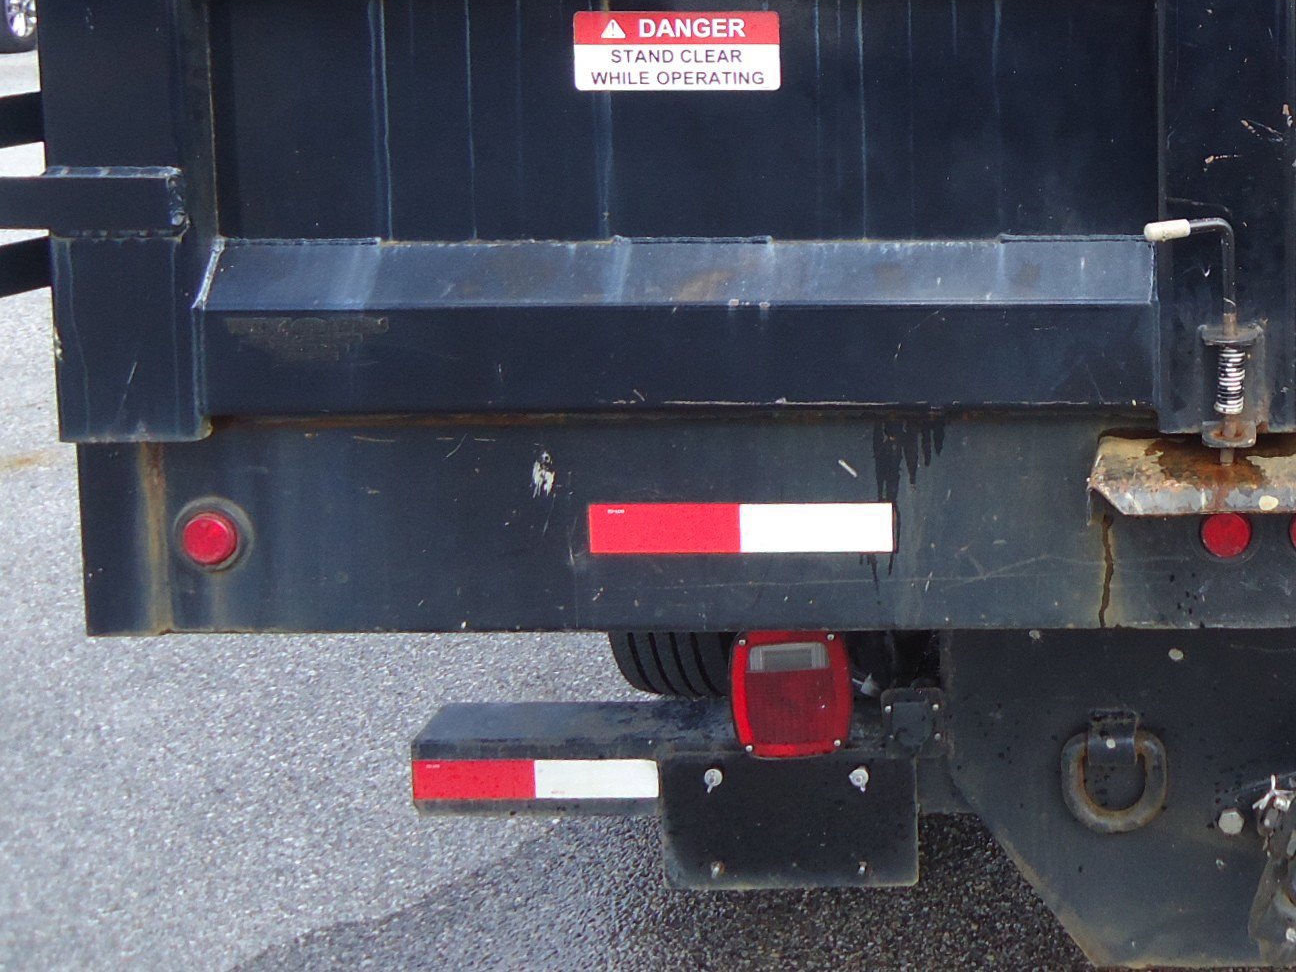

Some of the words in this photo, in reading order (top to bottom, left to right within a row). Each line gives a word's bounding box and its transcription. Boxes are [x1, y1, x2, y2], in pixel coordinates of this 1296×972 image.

[638, 18, 746, 38] DANGER
[610, 49, 674, 64] STAND
[680, 49, 743, 63] CLEAR
[590, 71, 650, 85] WHILE
[656, 71, 765, 85] OPERATING
